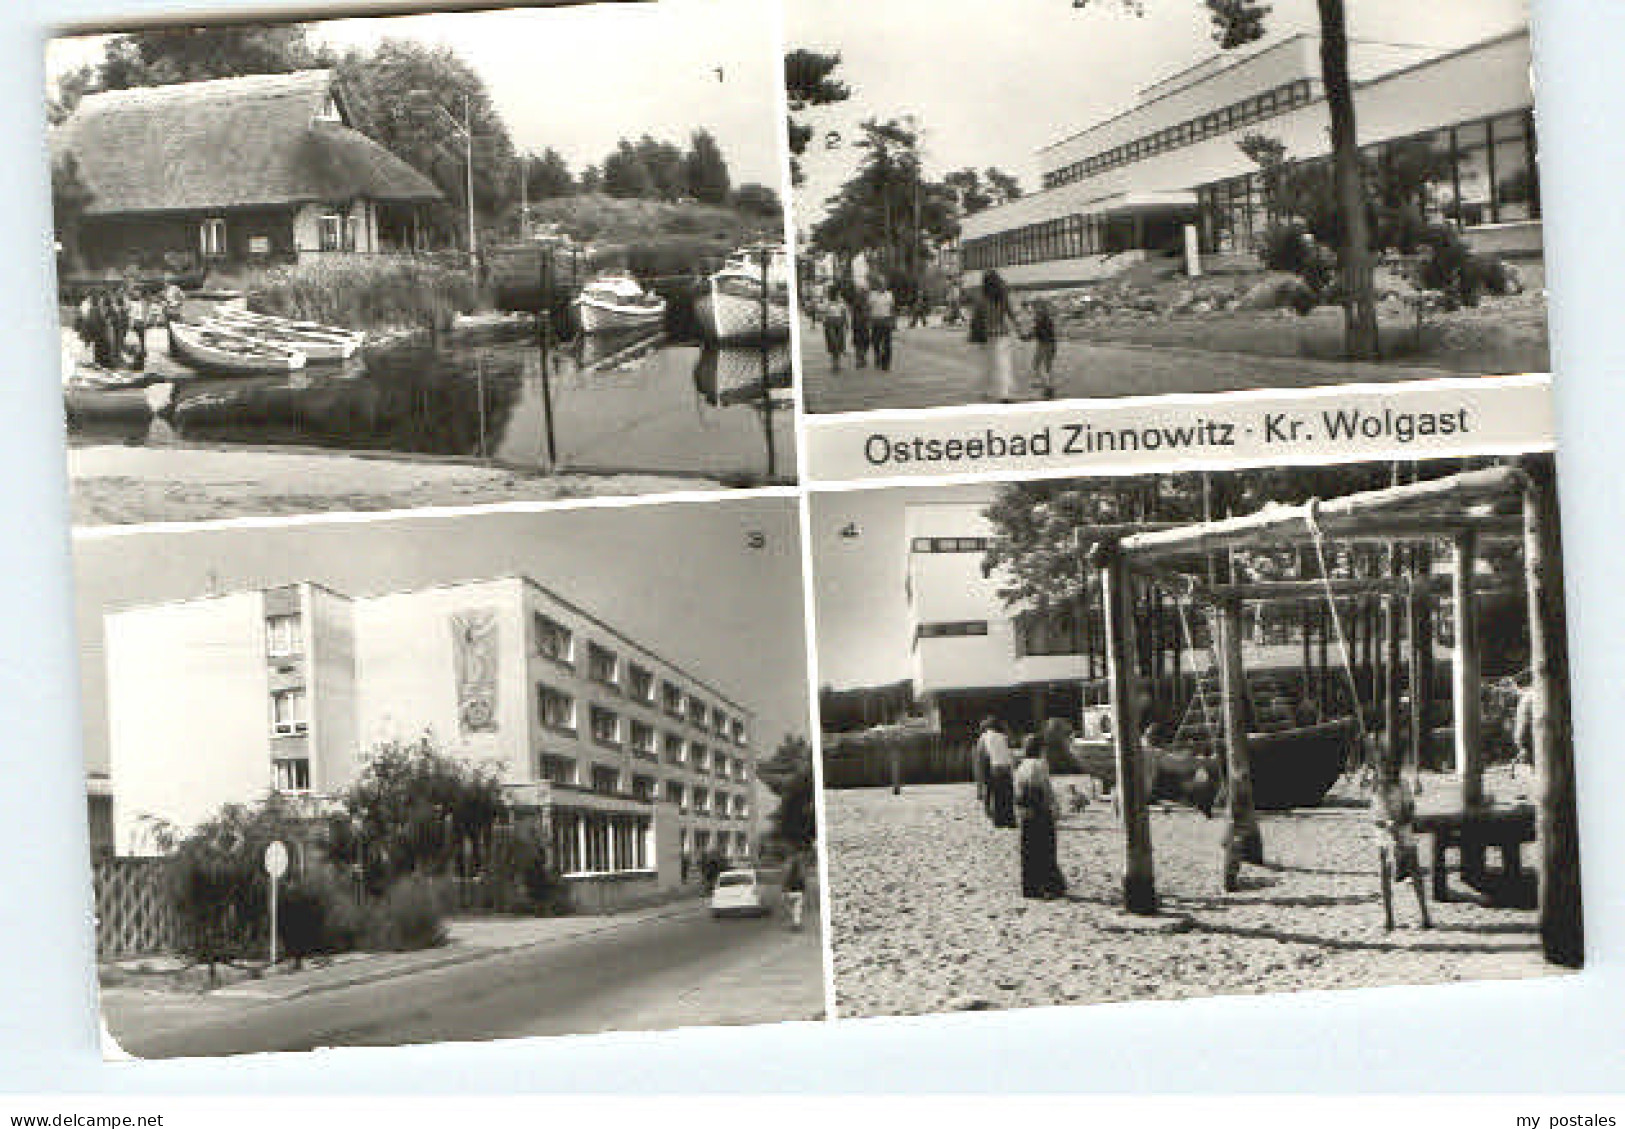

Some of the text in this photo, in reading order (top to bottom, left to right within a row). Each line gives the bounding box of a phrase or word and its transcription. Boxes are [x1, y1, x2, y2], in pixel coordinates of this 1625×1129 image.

[712, 66, 723, 83] 1
[825, 130, 841, 149] 2
[864, 406, 1470, 465] Ostseebad Zinnowitz Kr. Wolgast
[748, 529, 765, 548] 3
[839, 521, 859, 537] 4
